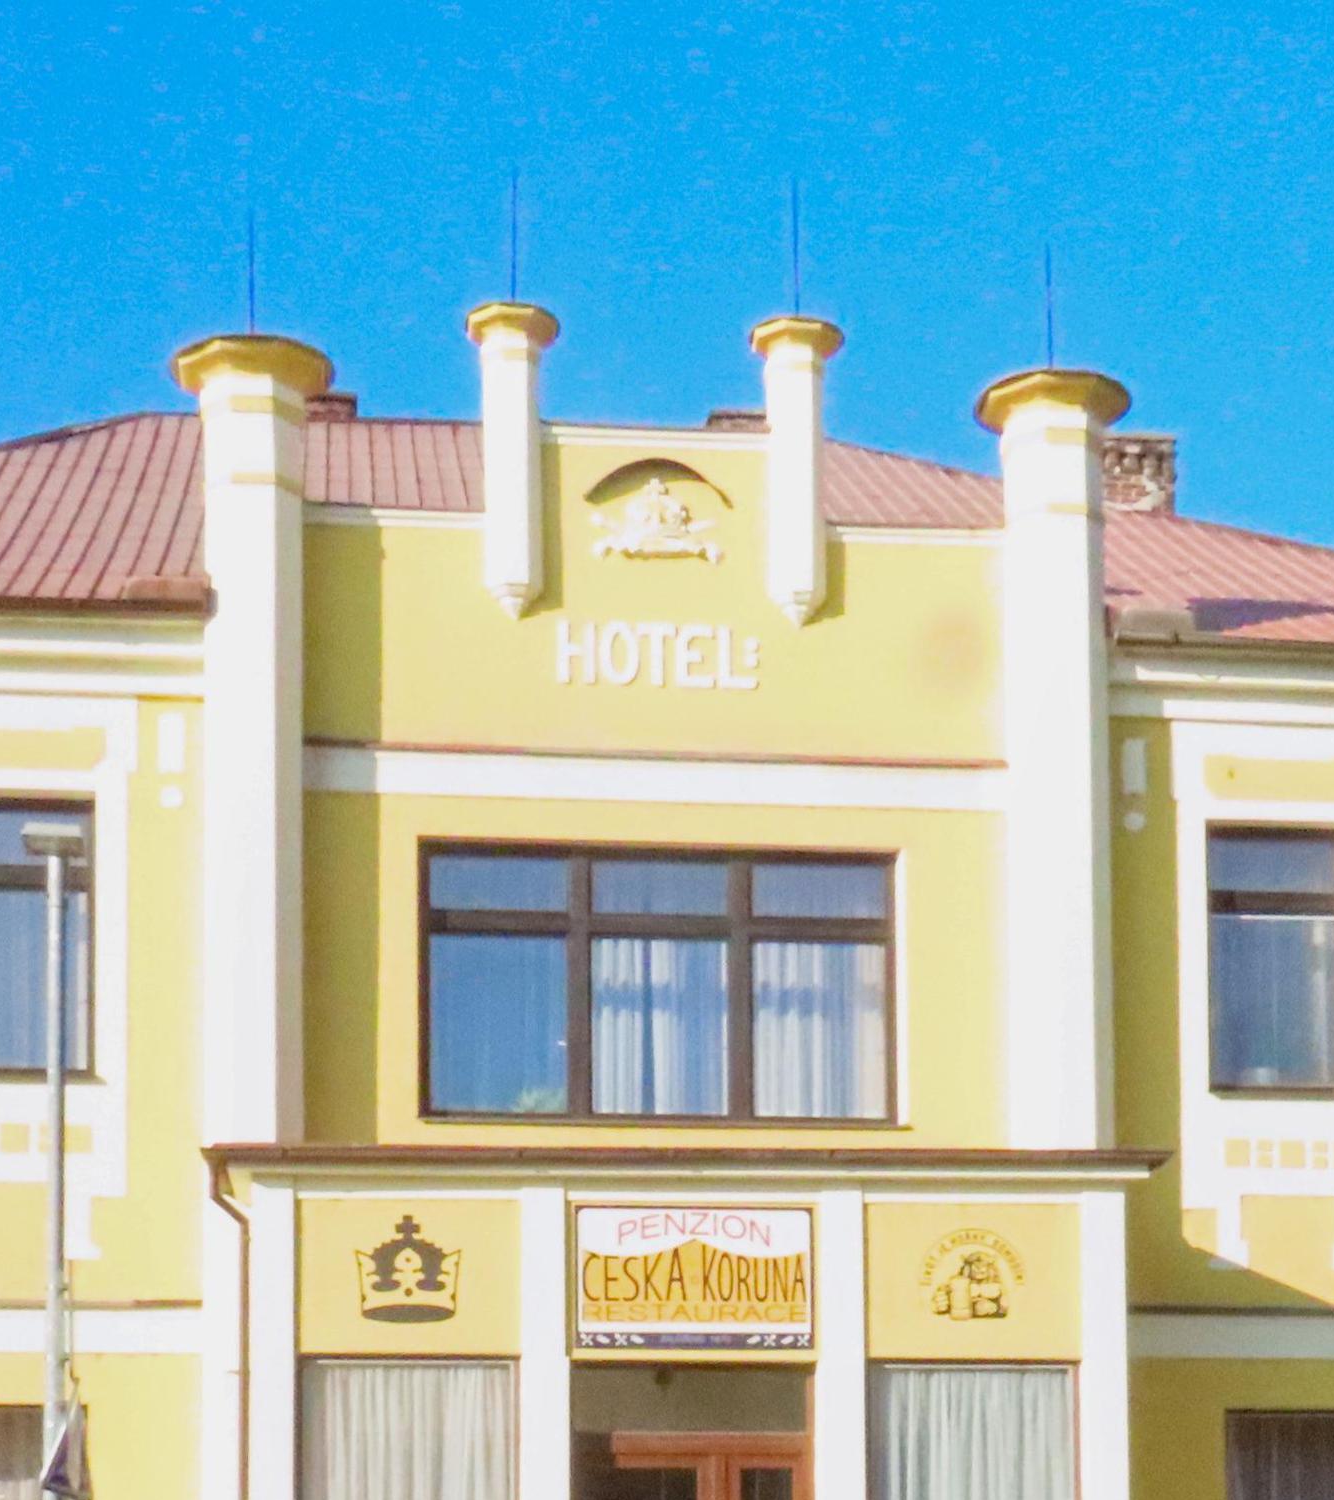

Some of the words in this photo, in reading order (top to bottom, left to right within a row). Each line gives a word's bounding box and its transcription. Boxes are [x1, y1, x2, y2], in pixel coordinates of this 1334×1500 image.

[617, 1210, 772, 1247] PENZION
[701, 1243, 808, 1303] KORUNA
[581, 1303, 807, 1323] RESTAURACE
